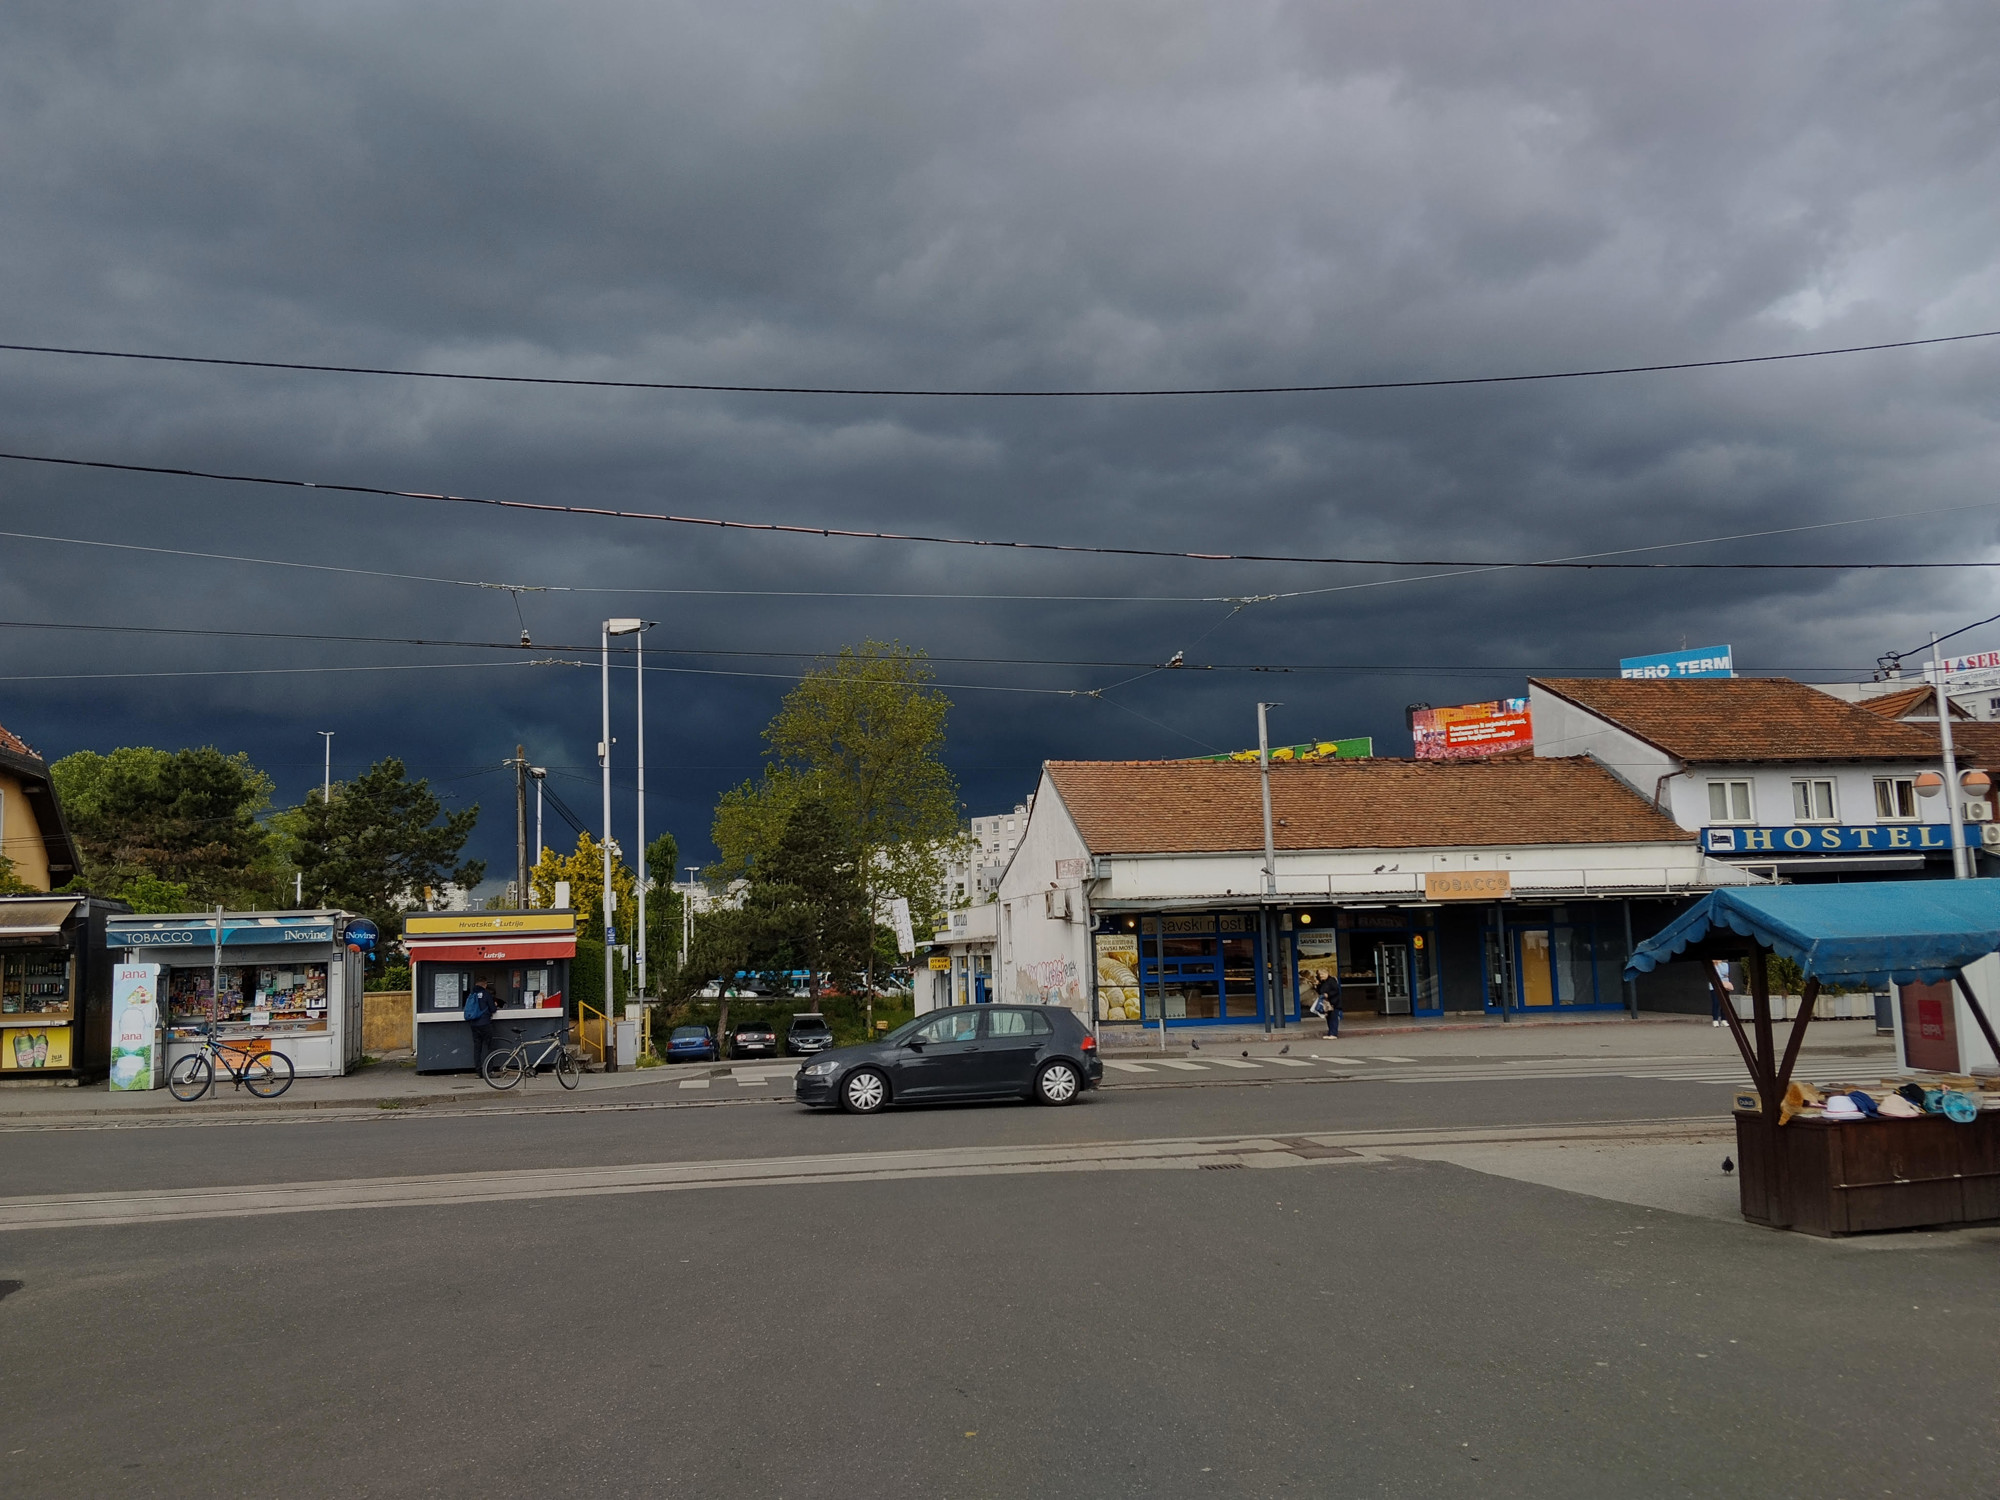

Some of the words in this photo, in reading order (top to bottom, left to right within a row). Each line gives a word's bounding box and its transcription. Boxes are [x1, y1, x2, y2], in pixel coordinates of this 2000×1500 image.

[1621, 664, 1670, 678] FERO
[1676, 656, 1730, 675] TERM
[1944, 652, 2000, 673] LASER
[1742, 827, 1944, 849] HOSTEL
[1429, 878, 1508, 892] TOBACCO
[500, 920, 524, 928] Lutrija
[126, 931, 192, 944] TOBACCO
[284, 930, 327, 941] iNovine
